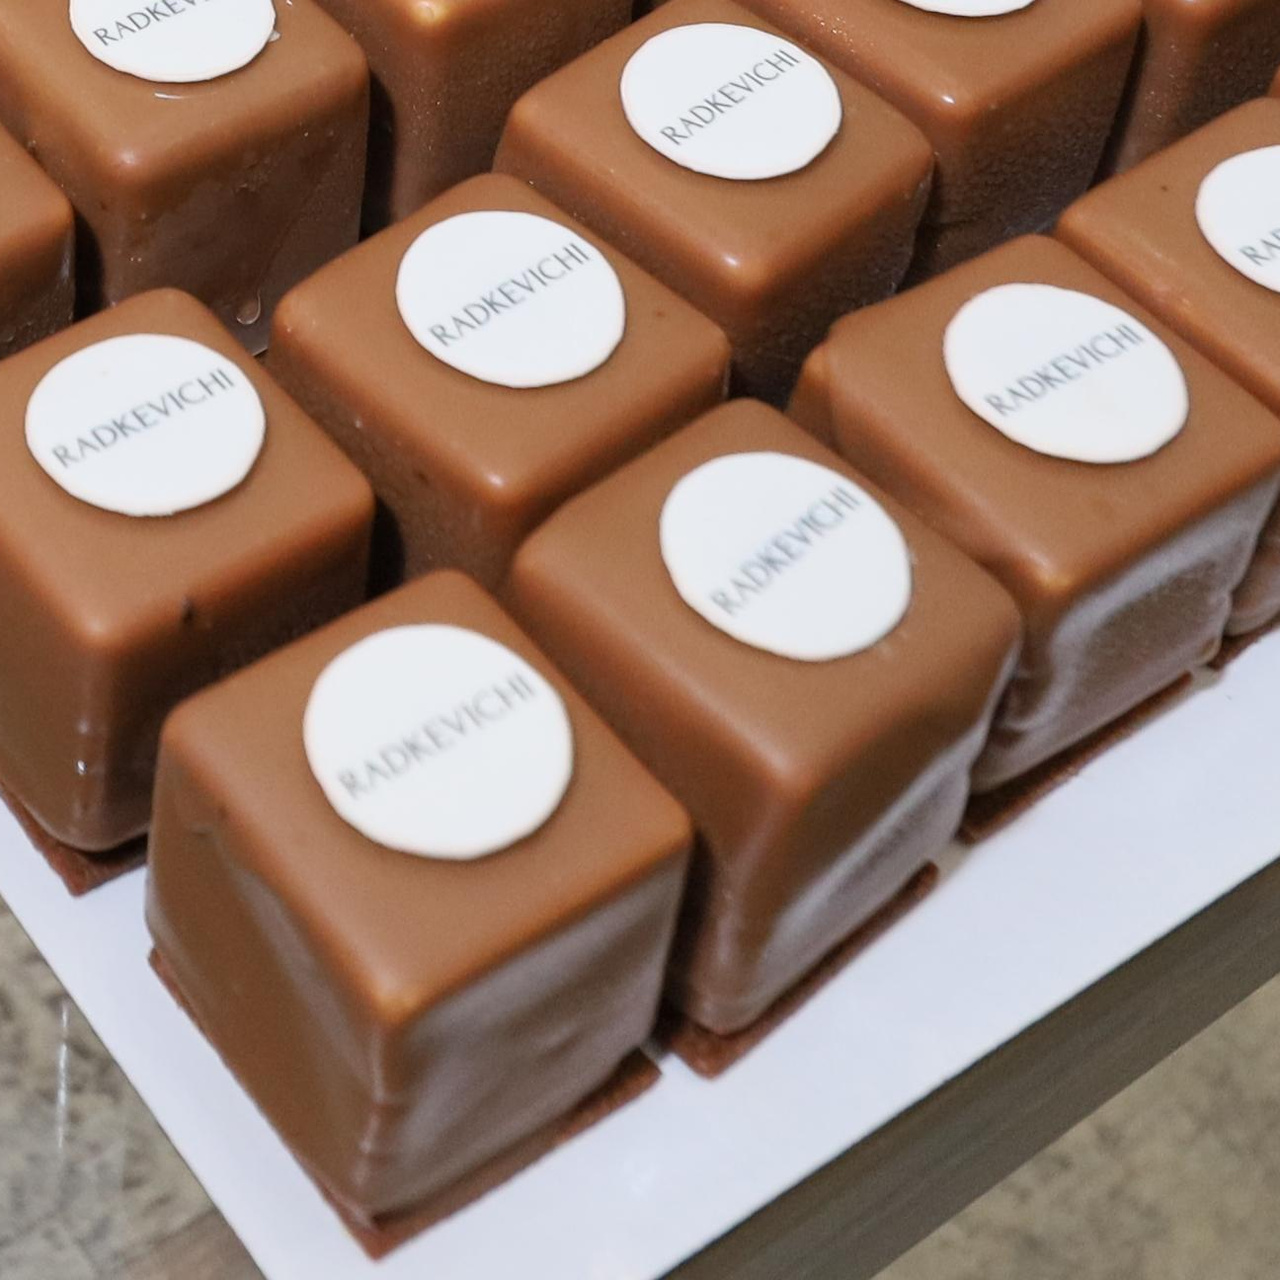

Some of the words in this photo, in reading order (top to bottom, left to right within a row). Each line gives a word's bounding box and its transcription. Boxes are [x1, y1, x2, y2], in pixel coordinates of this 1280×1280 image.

[660, 49, 801, 145] RADKEVICHI
[429, 243, 590, 347] RADKEVICHI
[51, 368, 235, 468] RADKEVICHI
[984, 324, 1144, 416] RADKEVICHI
[710, 486, 860, 616] RADKEVICHI
[337, 673, 536, 799] RADKEVICHI
